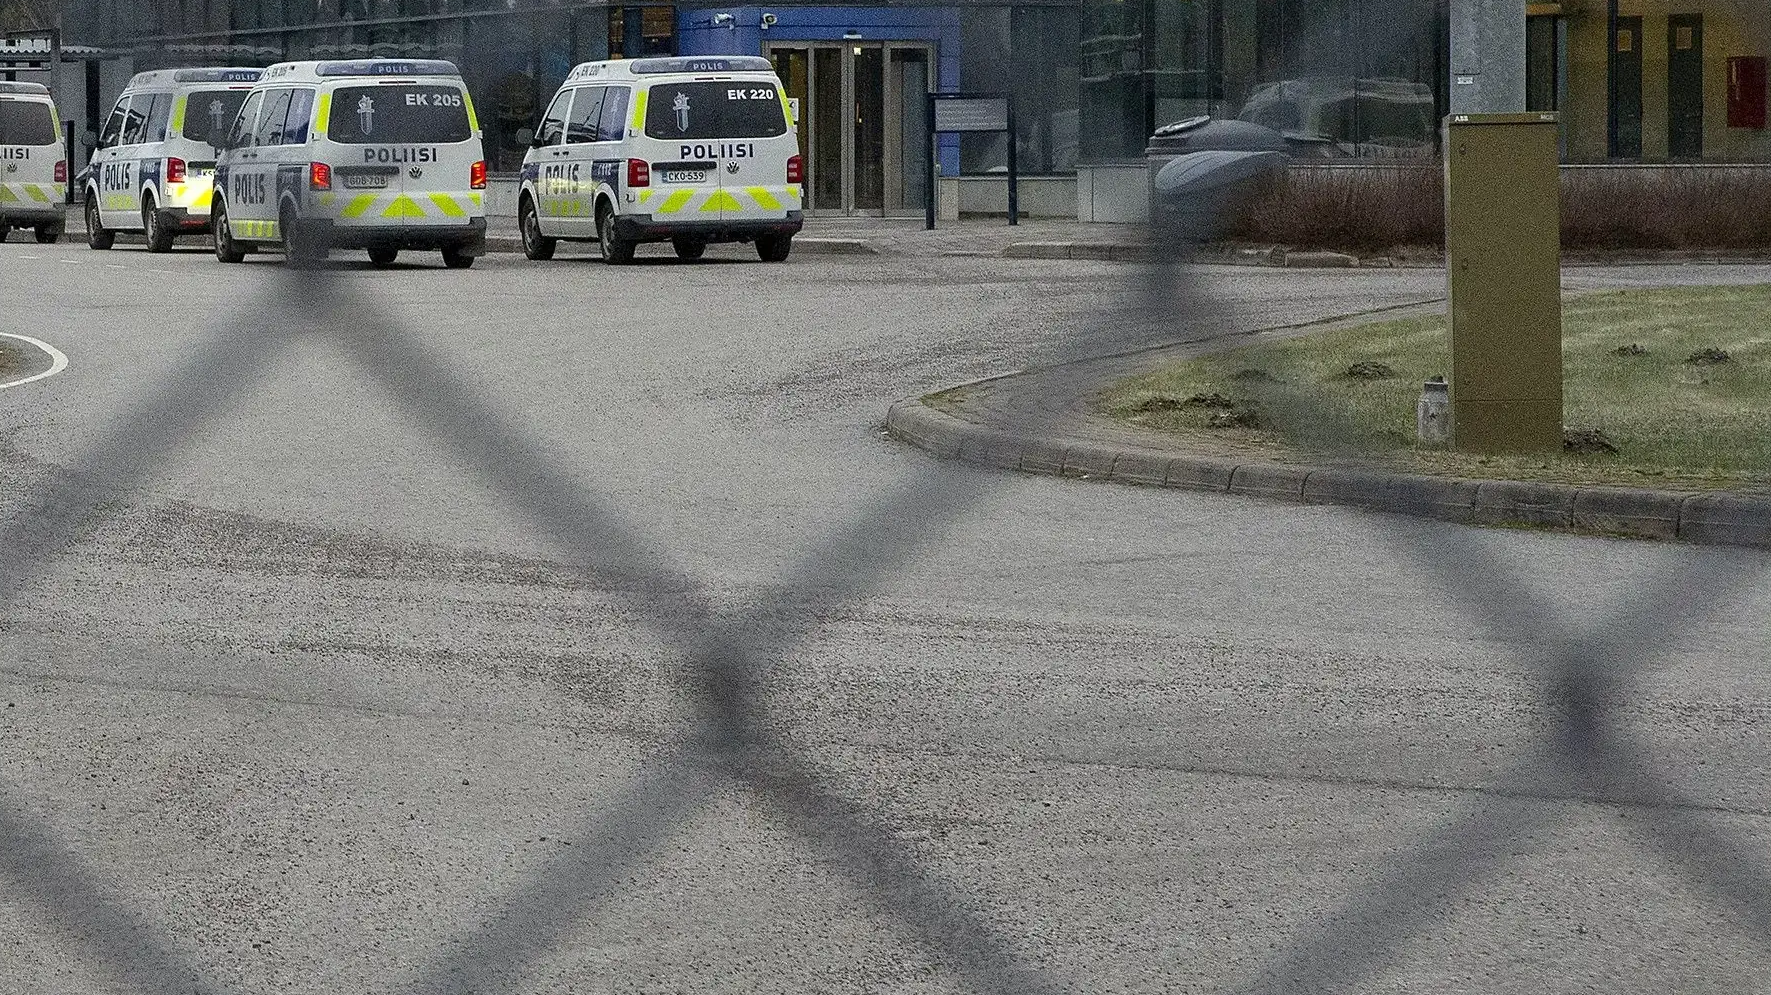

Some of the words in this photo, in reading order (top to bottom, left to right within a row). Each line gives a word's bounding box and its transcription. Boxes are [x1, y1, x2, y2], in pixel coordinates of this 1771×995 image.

[379, 65, 409, 73] POLIS
[693, 62, 724, 70] POLIS
[228, 73, 256, 81] POLIS
[405, 94, 428, 106] EK
[432, 94, 461, 107] 205
[727, 90, 747, 100] EK
[750, 89, 774, 100] 220
[363, 147, 437, 163] POLIISI
[680, 144, 754, 160] POLIISI
[105, 162, 131, 191] POLIS
[545, 163, 581, 196] POLIS
[668, 171, 704, 181] CKO-539
[234, 173, 266, 205] POLIS
